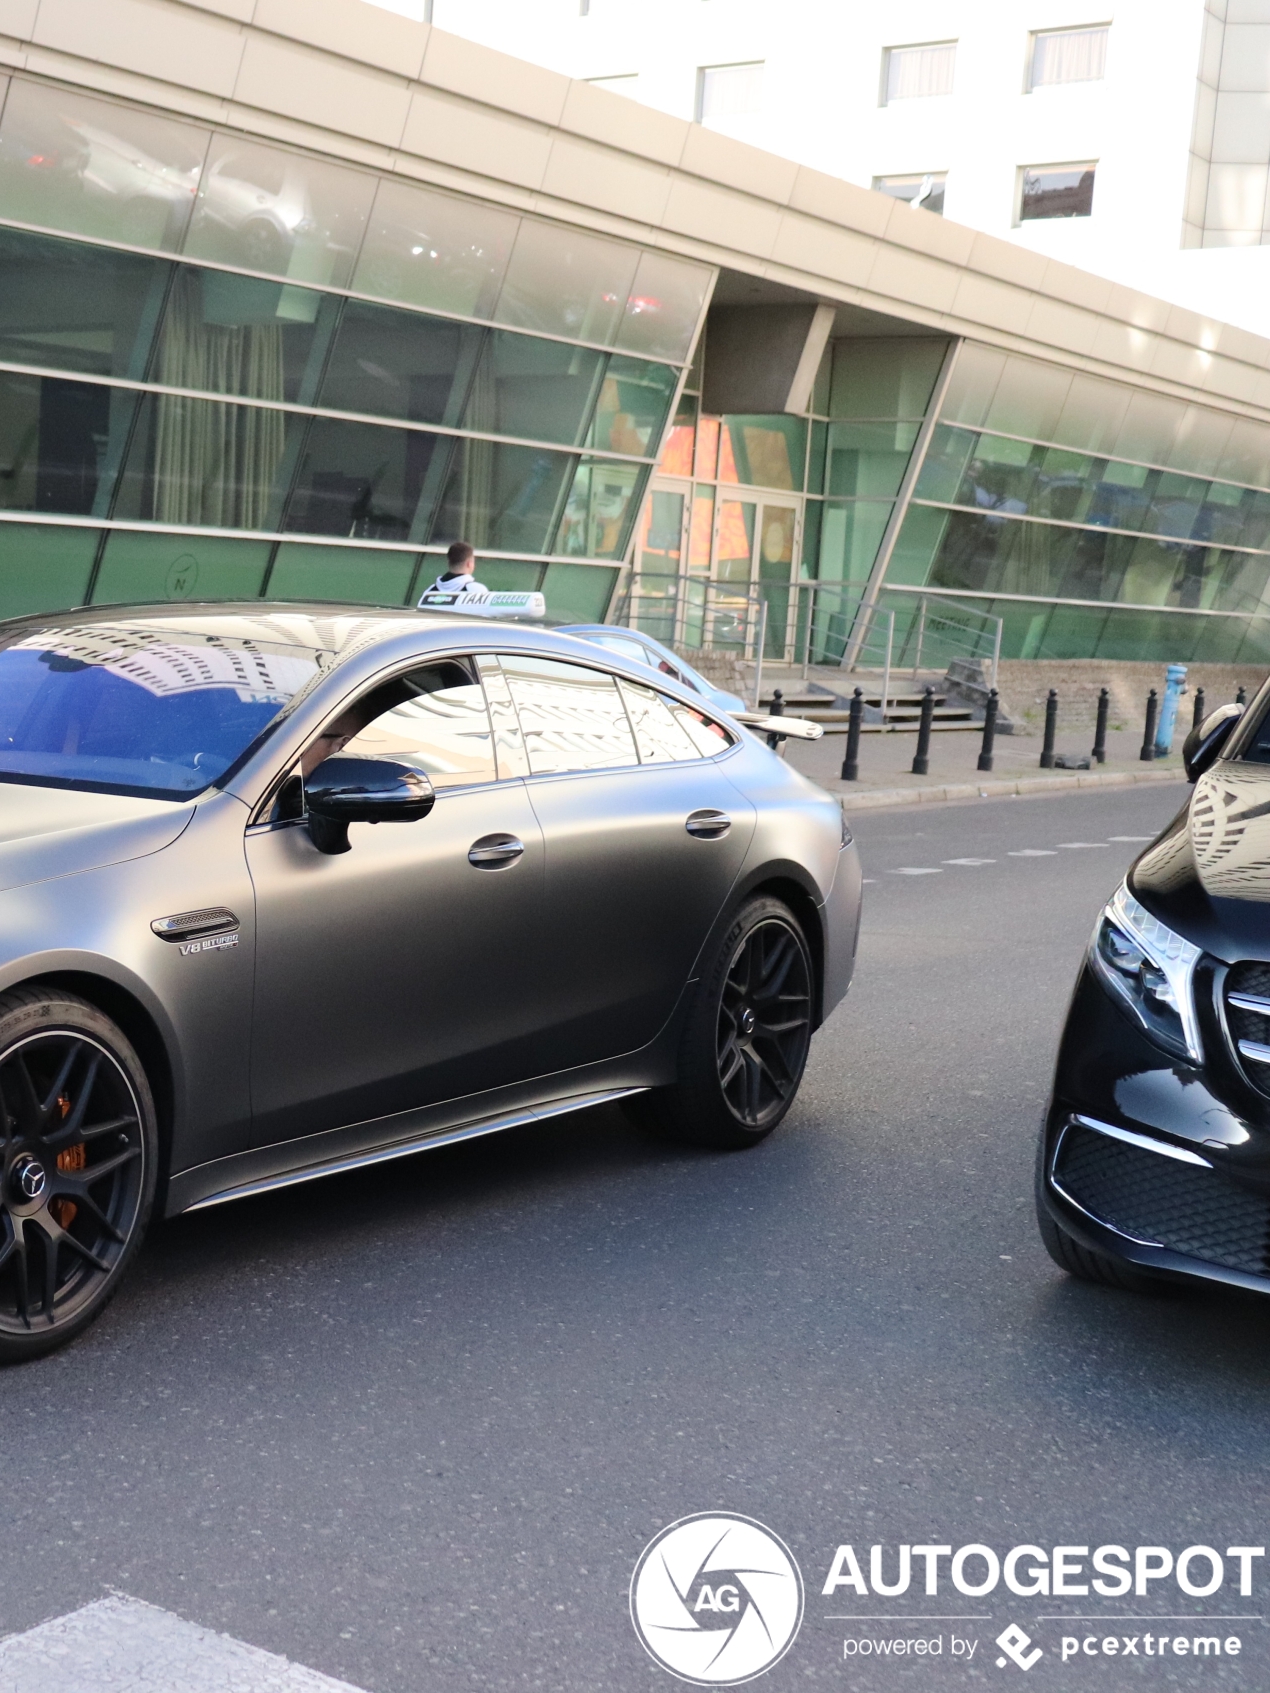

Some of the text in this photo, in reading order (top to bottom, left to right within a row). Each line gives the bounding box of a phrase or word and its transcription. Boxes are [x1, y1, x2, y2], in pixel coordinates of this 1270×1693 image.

[461, 592, 490, 605] TAXI
[179, 942, 201, 956] V8
[202, 934, 239, 948] BITURBO
